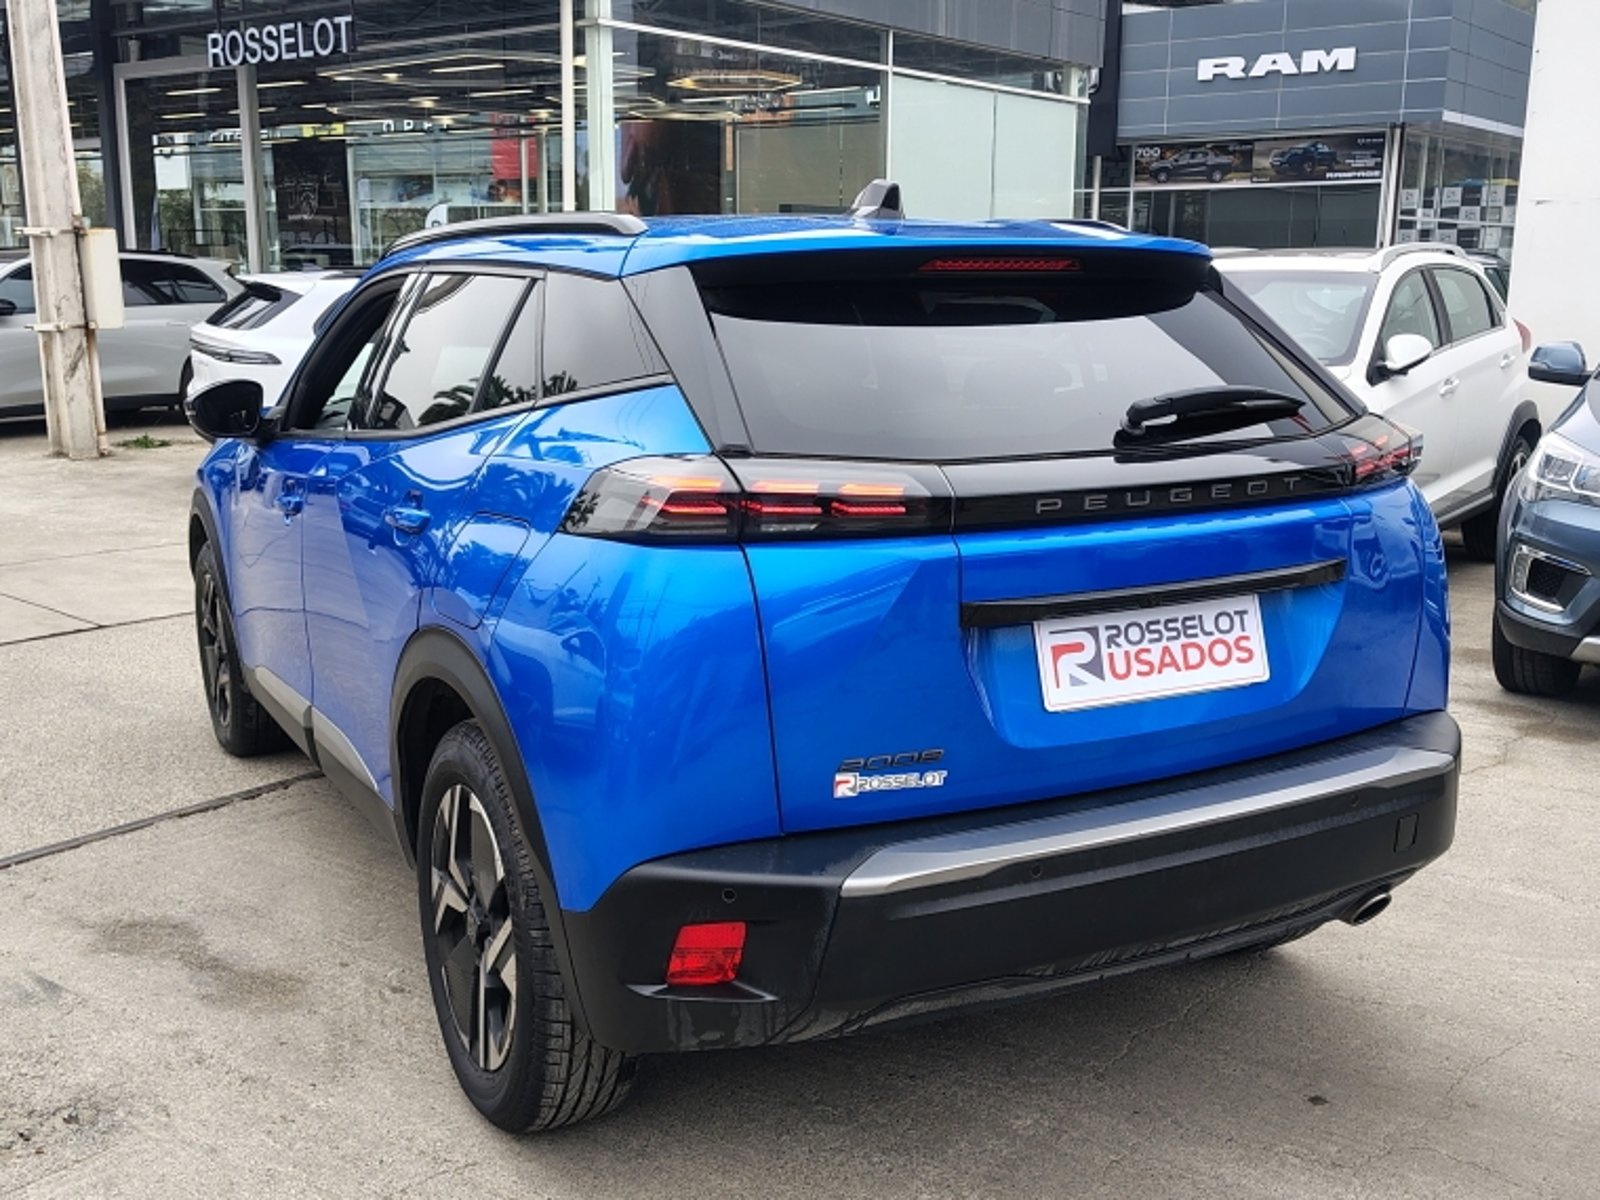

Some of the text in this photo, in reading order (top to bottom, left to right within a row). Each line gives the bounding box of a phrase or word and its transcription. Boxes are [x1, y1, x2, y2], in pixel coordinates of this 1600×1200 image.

[207, 15, 352, 68] ROSSELOT
[1197, 46, 1357, 81] RAM
[1135, 147, 1161, 158] 700
[1036, 477, 1300, 514] PEUGEOT
[1105, 610, 1249, 649] ROSSELOT
[1107, 635, 1254, 681] USADOS
[838, 749, 944, 773] 2008
[858, 770, 948, 792] ROSSELOT
